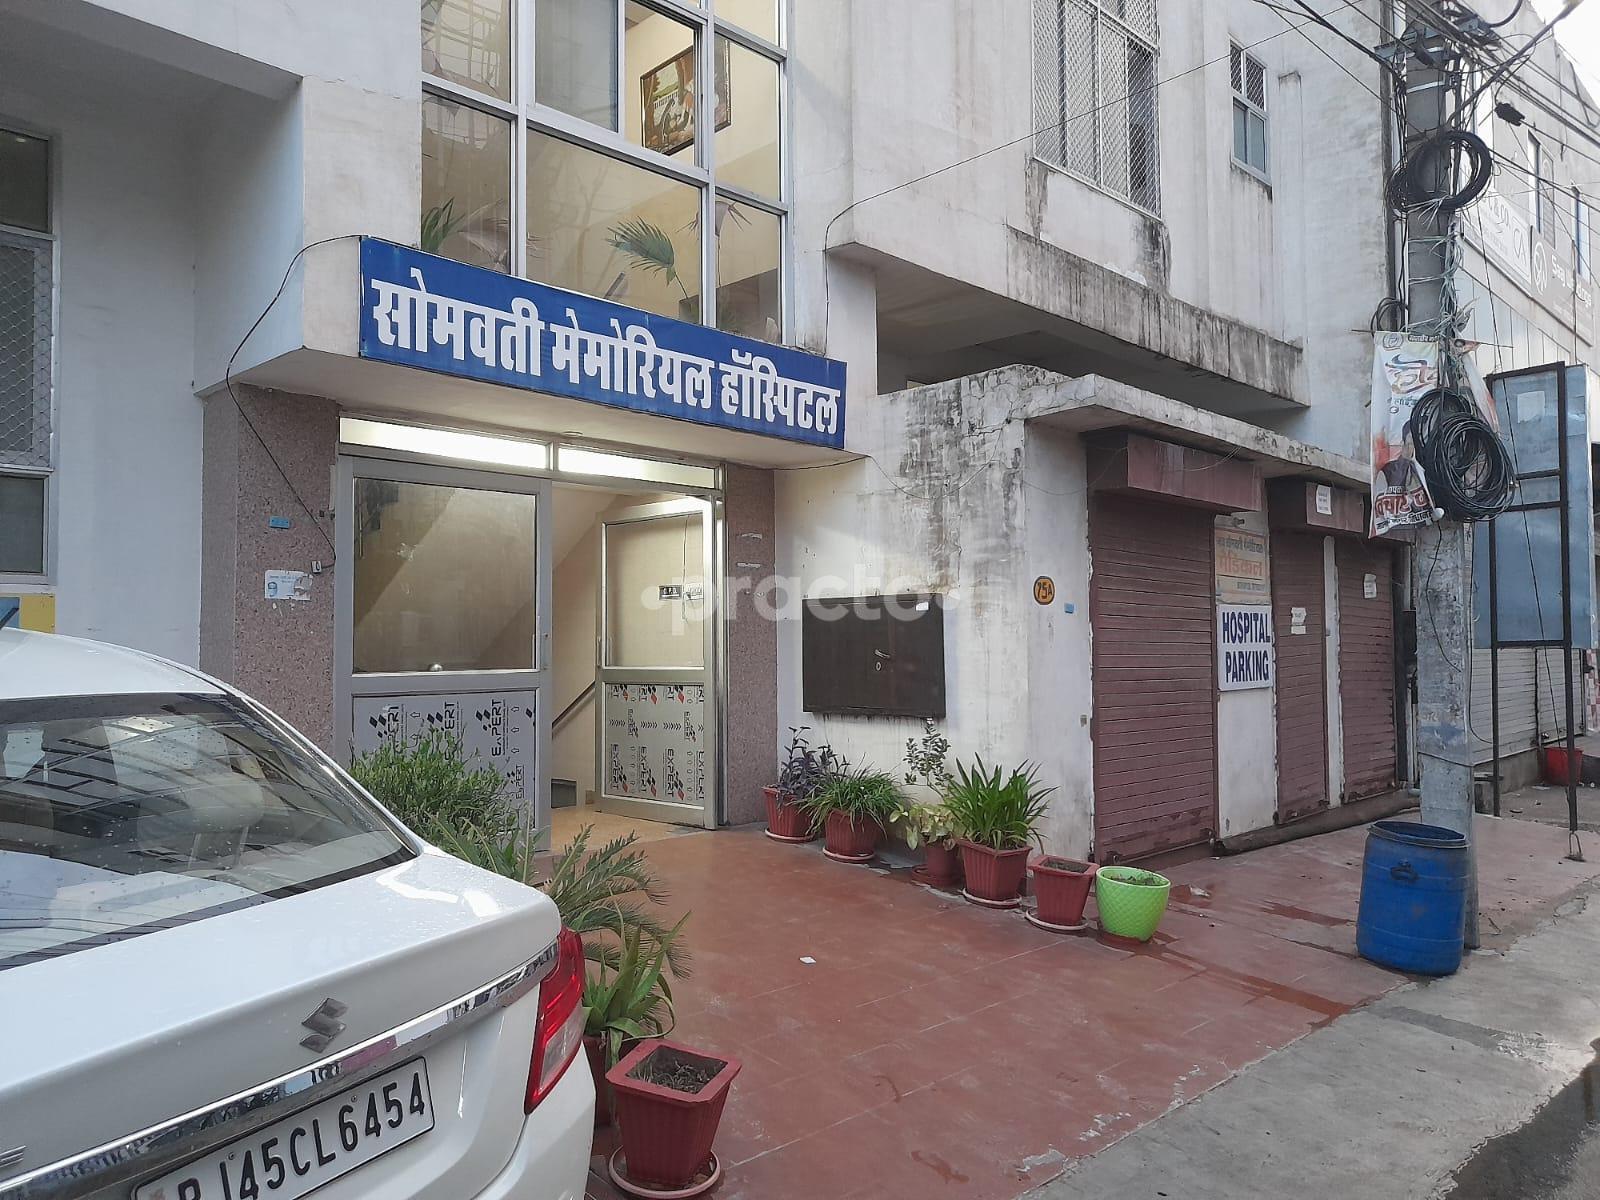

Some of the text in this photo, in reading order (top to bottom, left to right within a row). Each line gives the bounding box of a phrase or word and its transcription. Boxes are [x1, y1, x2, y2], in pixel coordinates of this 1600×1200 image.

[371, 267, 841, 436] सोमवती मेमोरियल हॉस्पिटल
[1222, 611, 1271, 644] HOSPITAL
[1225, 650, 1270, 683] PARKING
[612, 744, 620, 790] EXPERT
[640, 746, 648, 793] EXPERT
[667, 748, 675, 797] EXPERT
